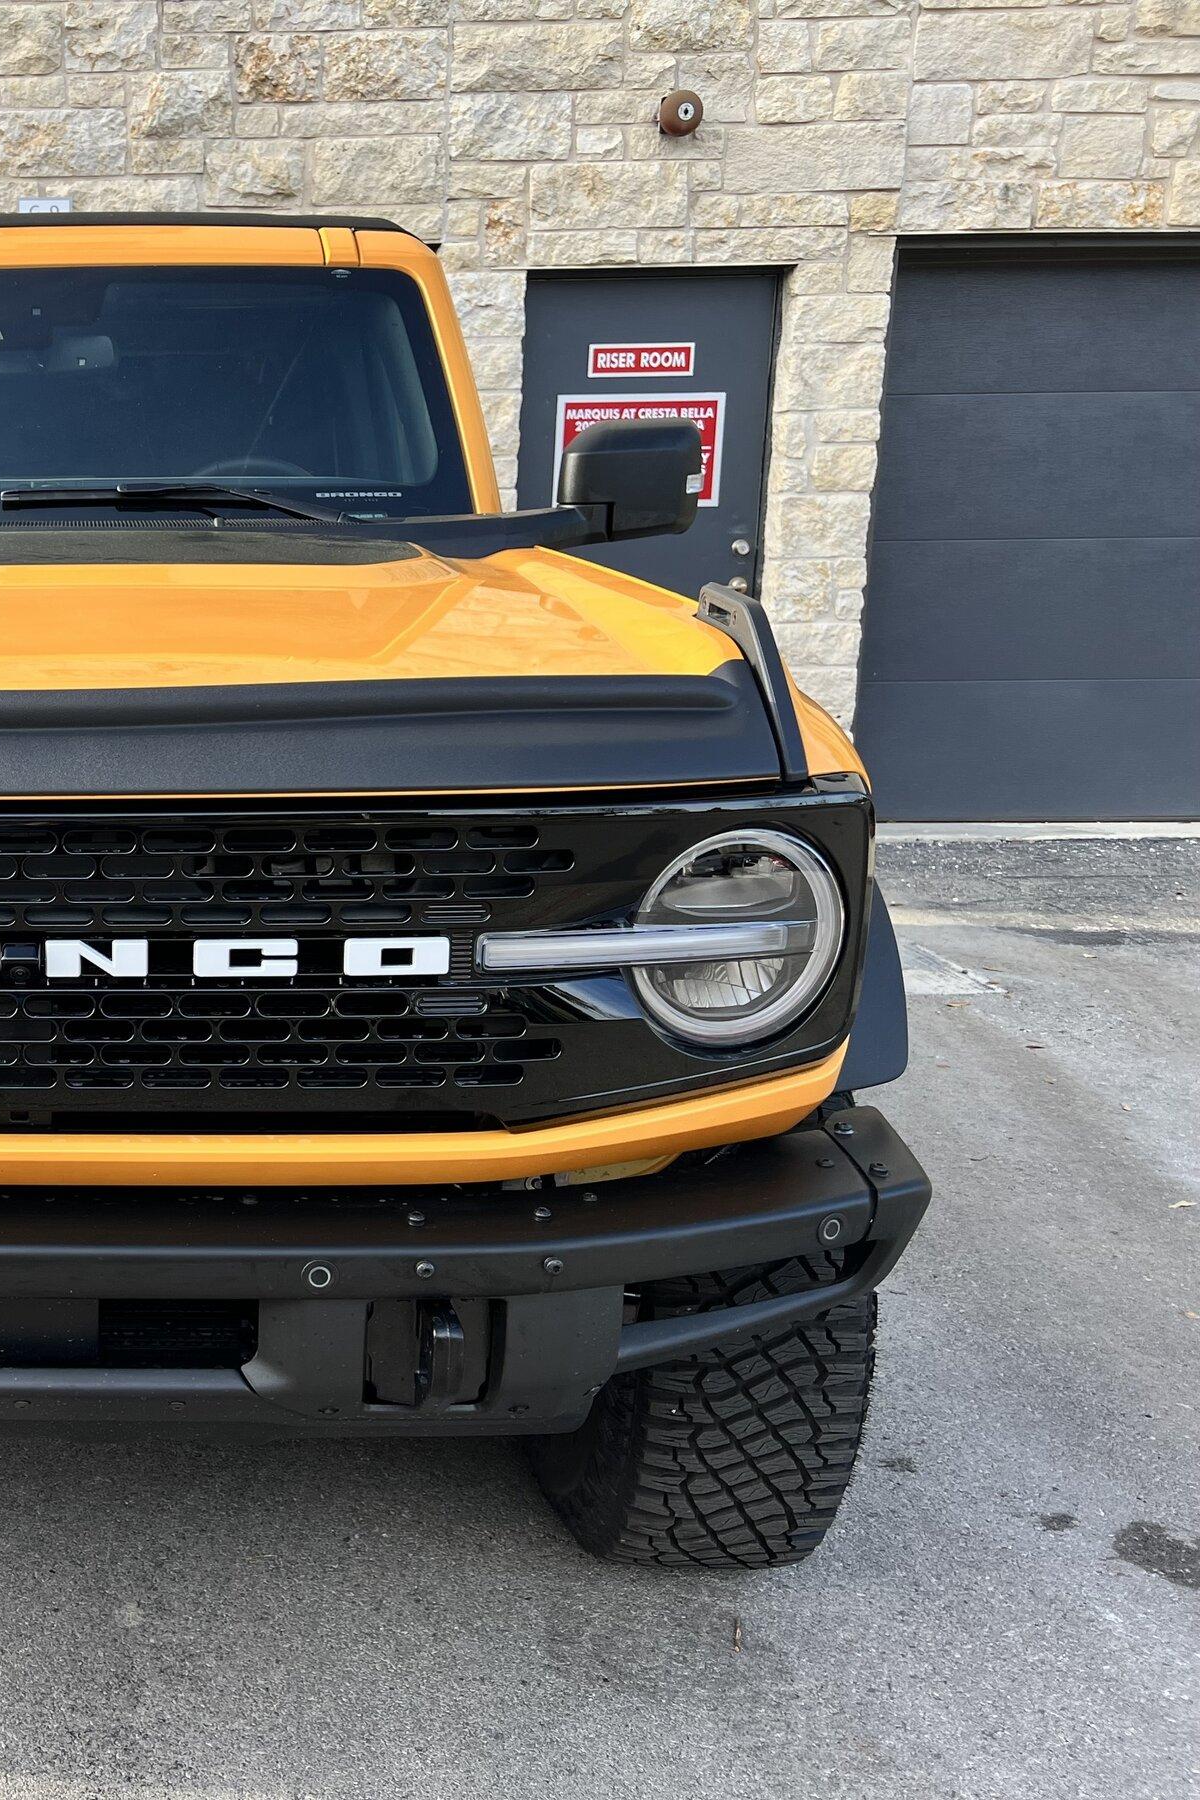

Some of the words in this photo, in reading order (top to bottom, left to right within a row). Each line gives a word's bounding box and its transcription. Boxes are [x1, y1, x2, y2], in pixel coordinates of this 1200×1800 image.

[596, 352, 636, 369] RISER
[640, 351, 686, 368] ROOM
[566, 408, 620, 420] MARQUIS
[621, 407, 637, 419] AT
[638, 407, 678, 419] CRESTA
[680, 406, 715, 419] BELLA
